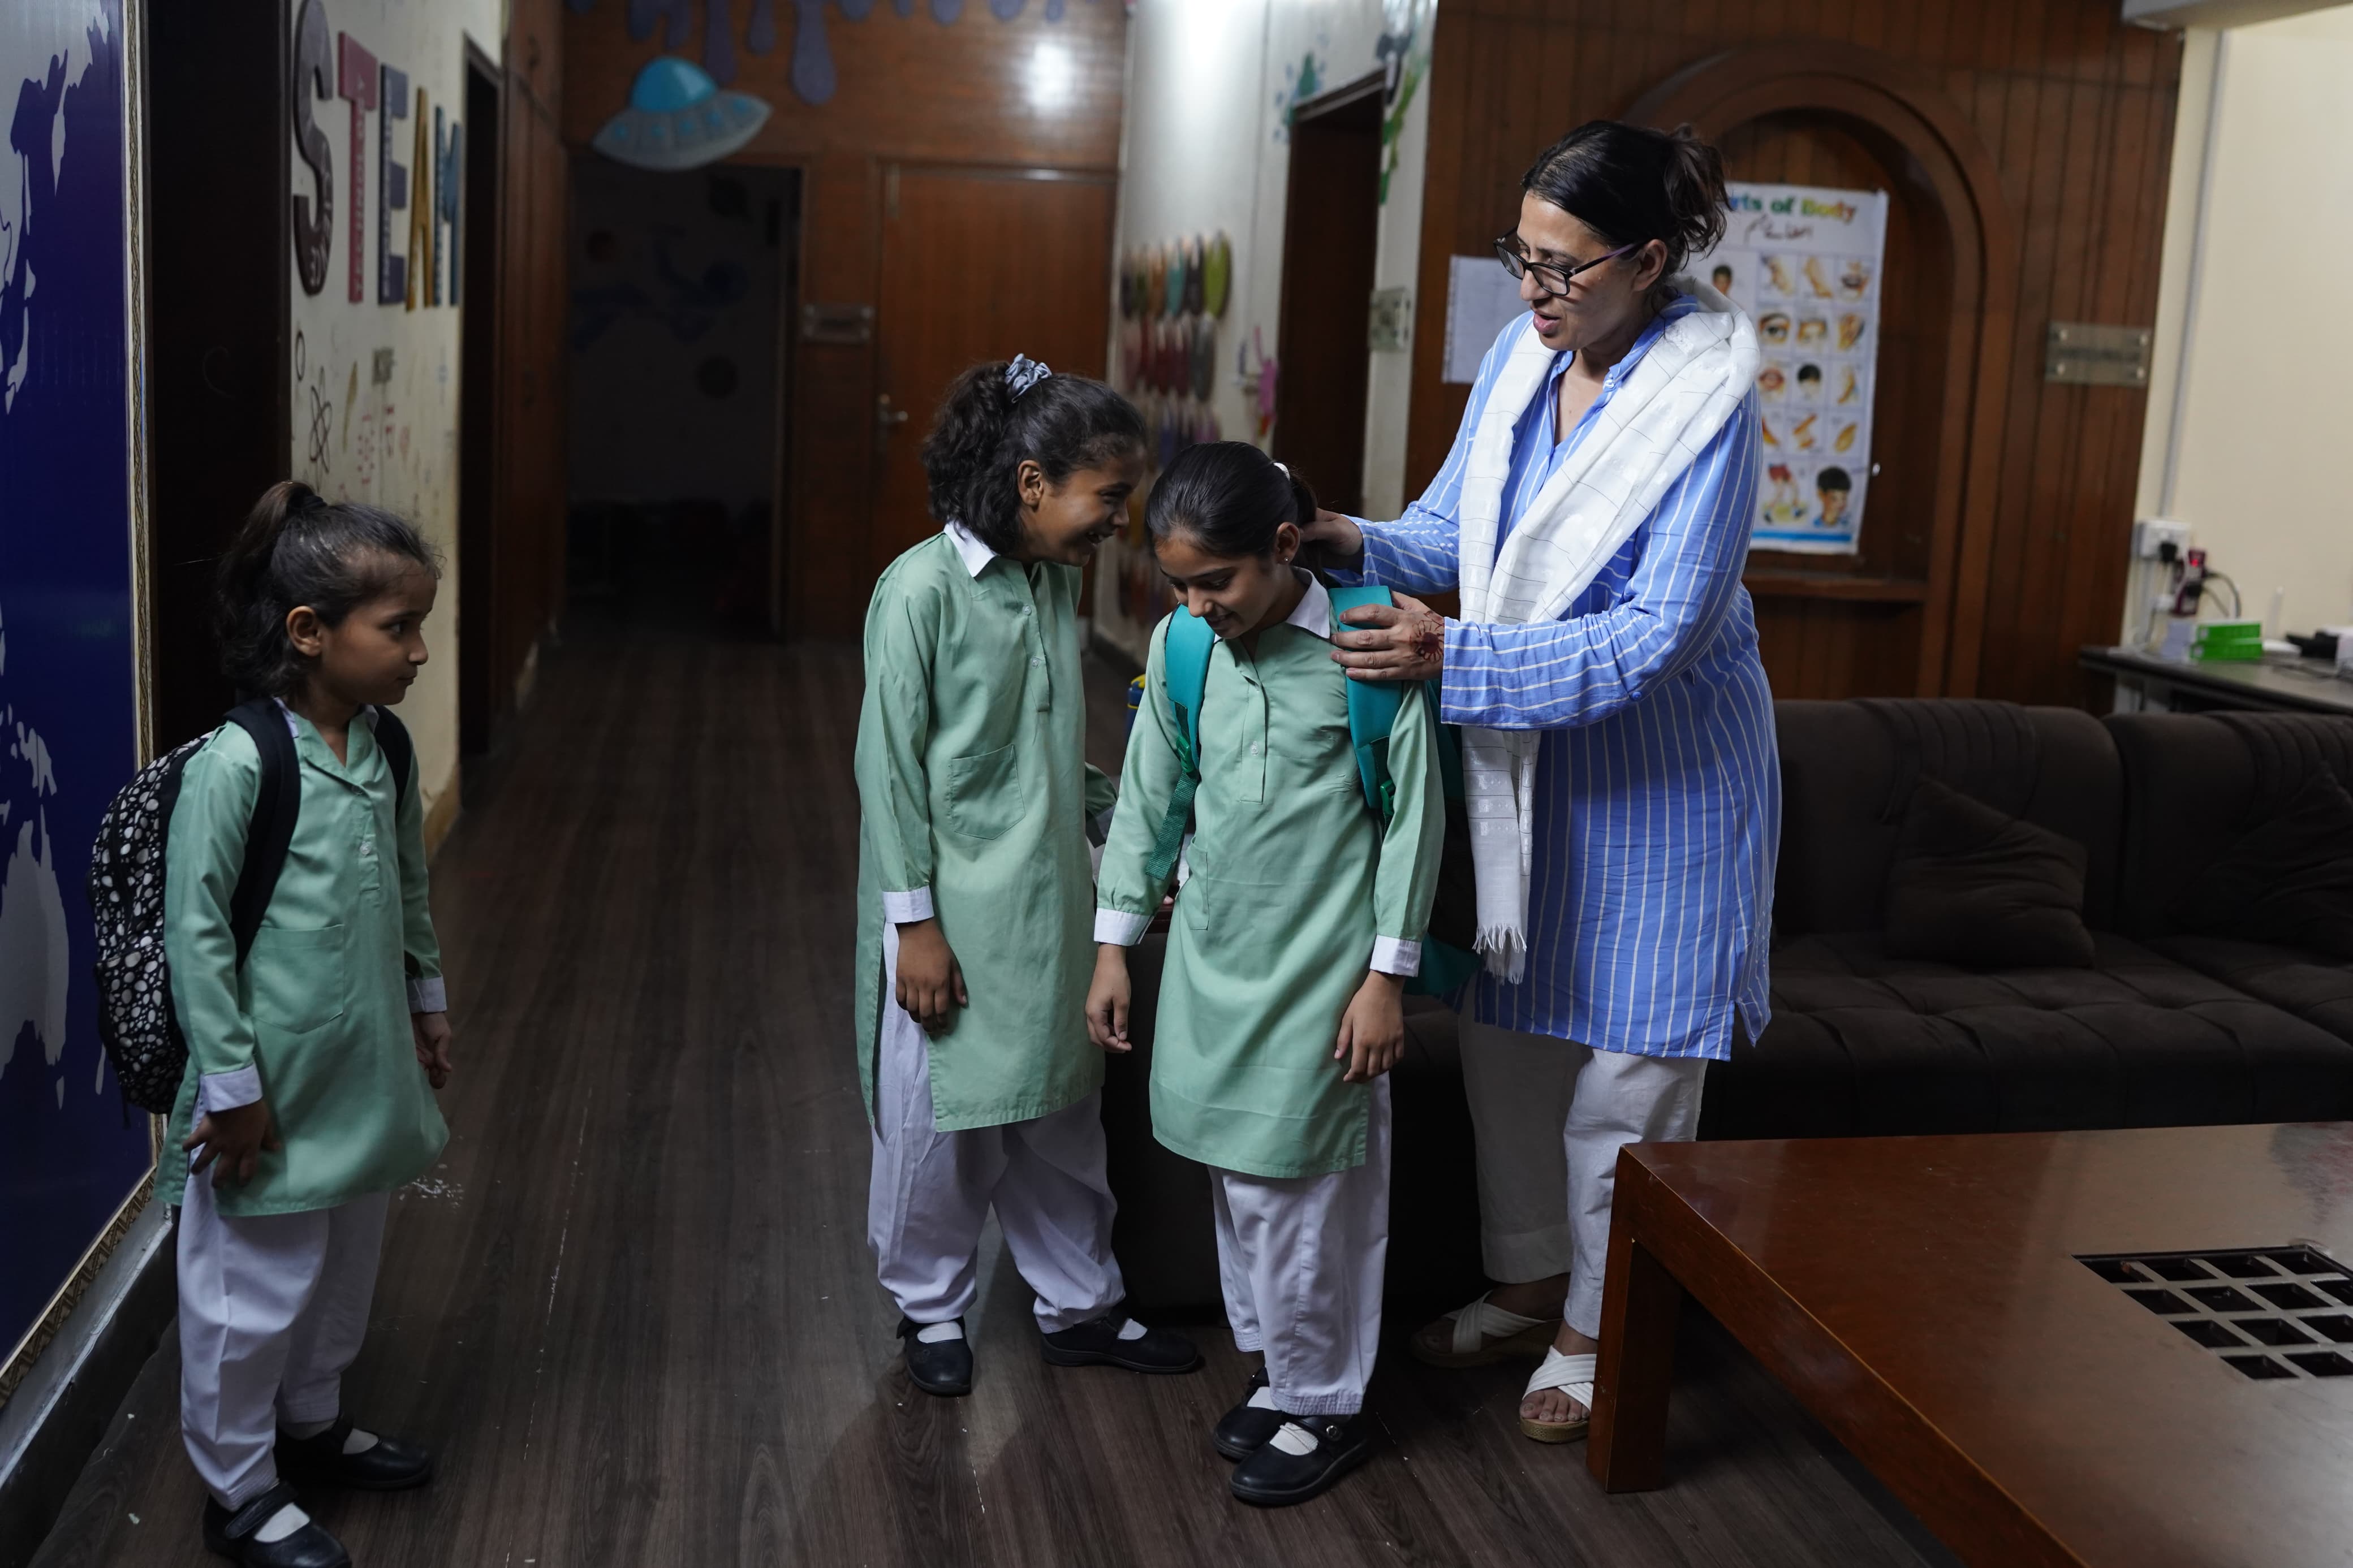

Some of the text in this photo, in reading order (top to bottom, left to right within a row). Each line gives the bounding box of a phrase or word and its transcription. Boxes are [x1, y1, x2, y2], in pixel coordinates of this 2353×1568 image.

[292, 0, 462, 312] STEAM
[1729, 193, 1856, 224] rts of Body
